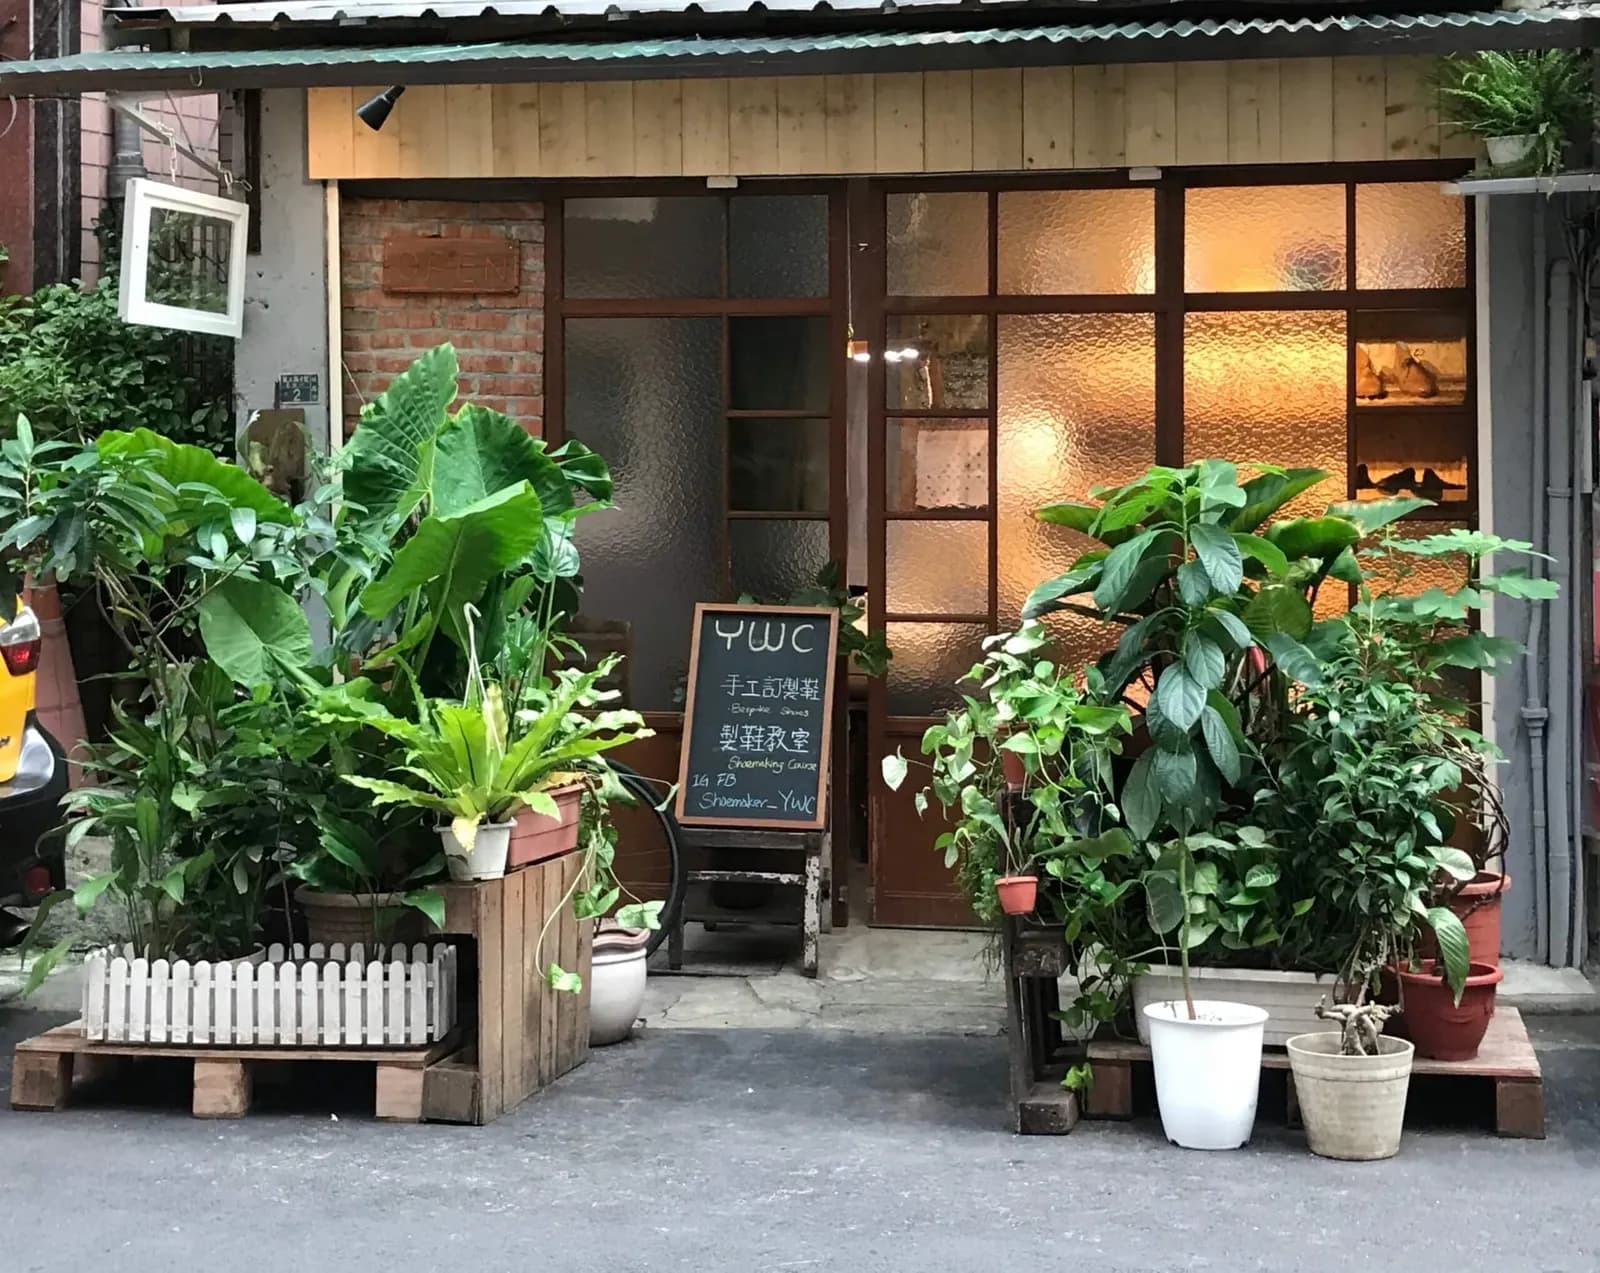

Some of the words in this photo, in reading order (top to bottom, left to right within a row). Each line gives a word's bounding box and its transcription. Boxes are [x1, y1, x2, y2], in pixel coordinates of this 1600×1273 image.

[292, 388, 302, 401] 2
[715, 619, 814, 653] YWC
[720, 674, 821, 701] 手工訂製鞋
[719, 723, 810, 753] 製鞋教室
[727, 755, 785, 774] Shoemaking
[787, 758, 817, 771] Course
[716, 772, 737, 787] FB
